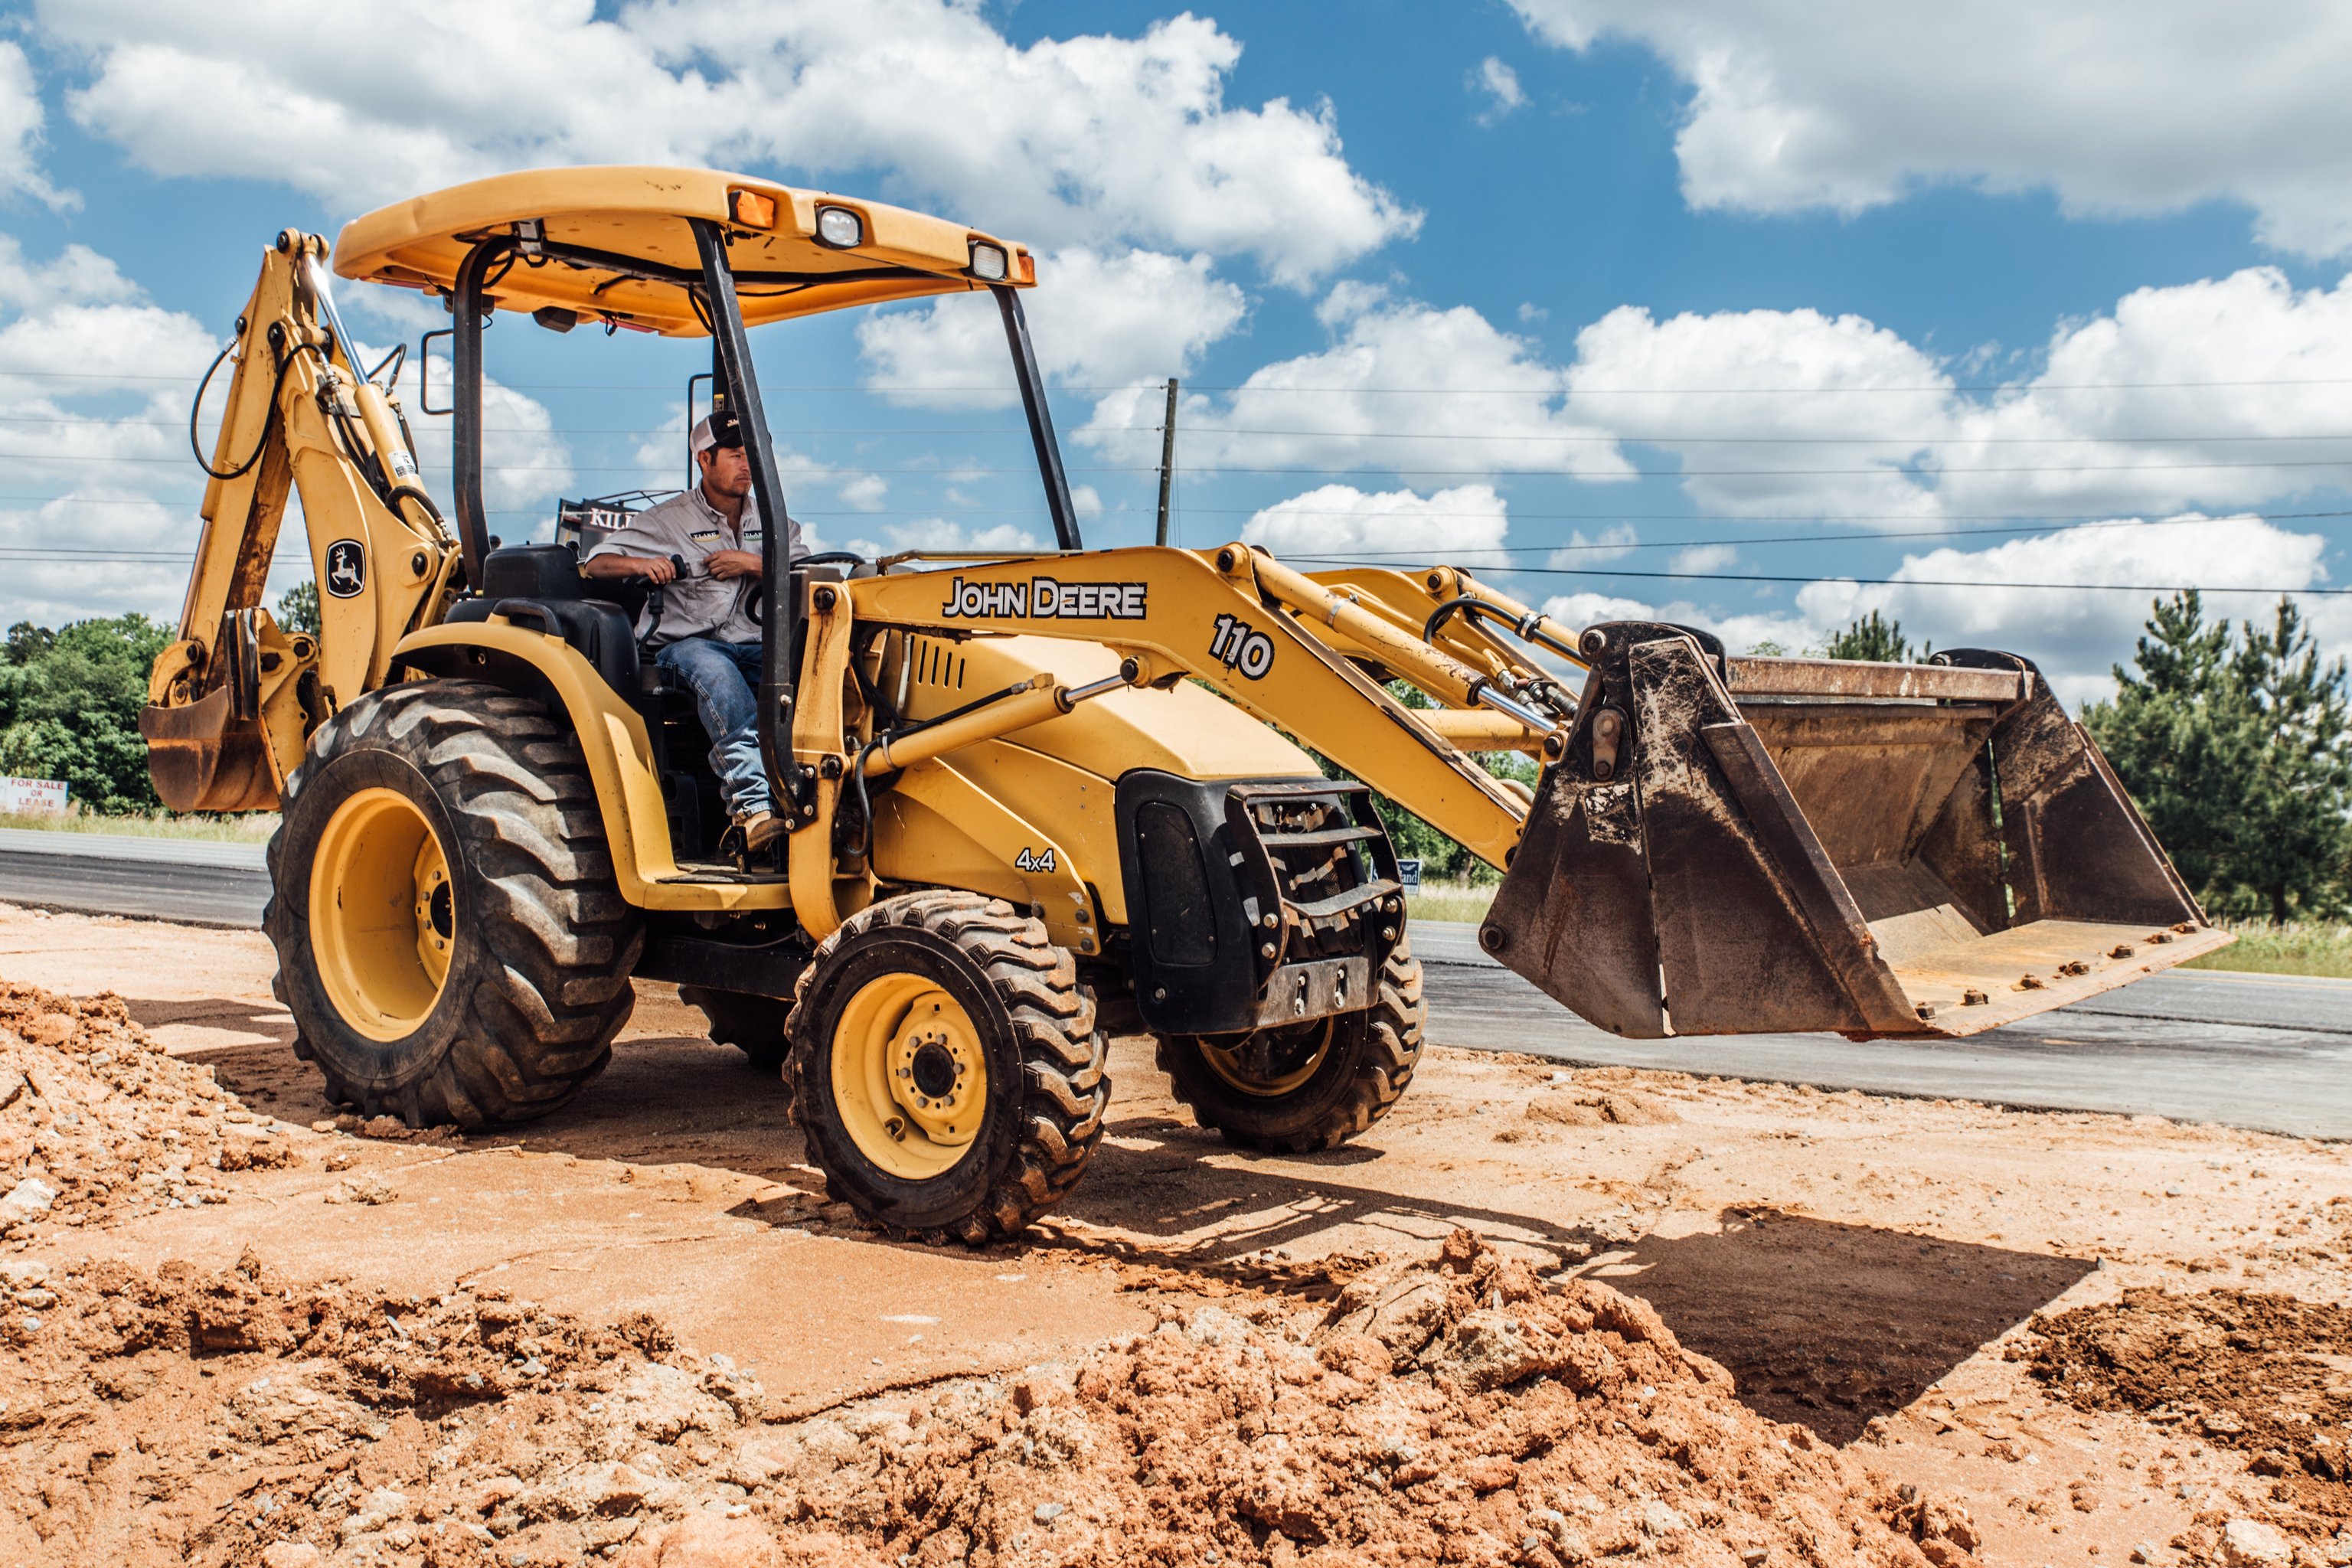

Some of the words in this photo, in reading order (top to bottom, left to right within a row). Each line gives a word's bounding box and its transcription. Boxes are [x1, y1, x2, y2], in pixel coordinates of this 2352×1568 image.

[942, 577, 1027, 618] JOHN
[1031, 577, 1148, 619] DEERE
[1208, 612, 1275, 681] 110
[11, 778, 32, 787] FOR
[37, 780, 64, 790] SALE
[18, 797, 54, 807] LEASE
[1015, 847, 1056, 873] 4x4
